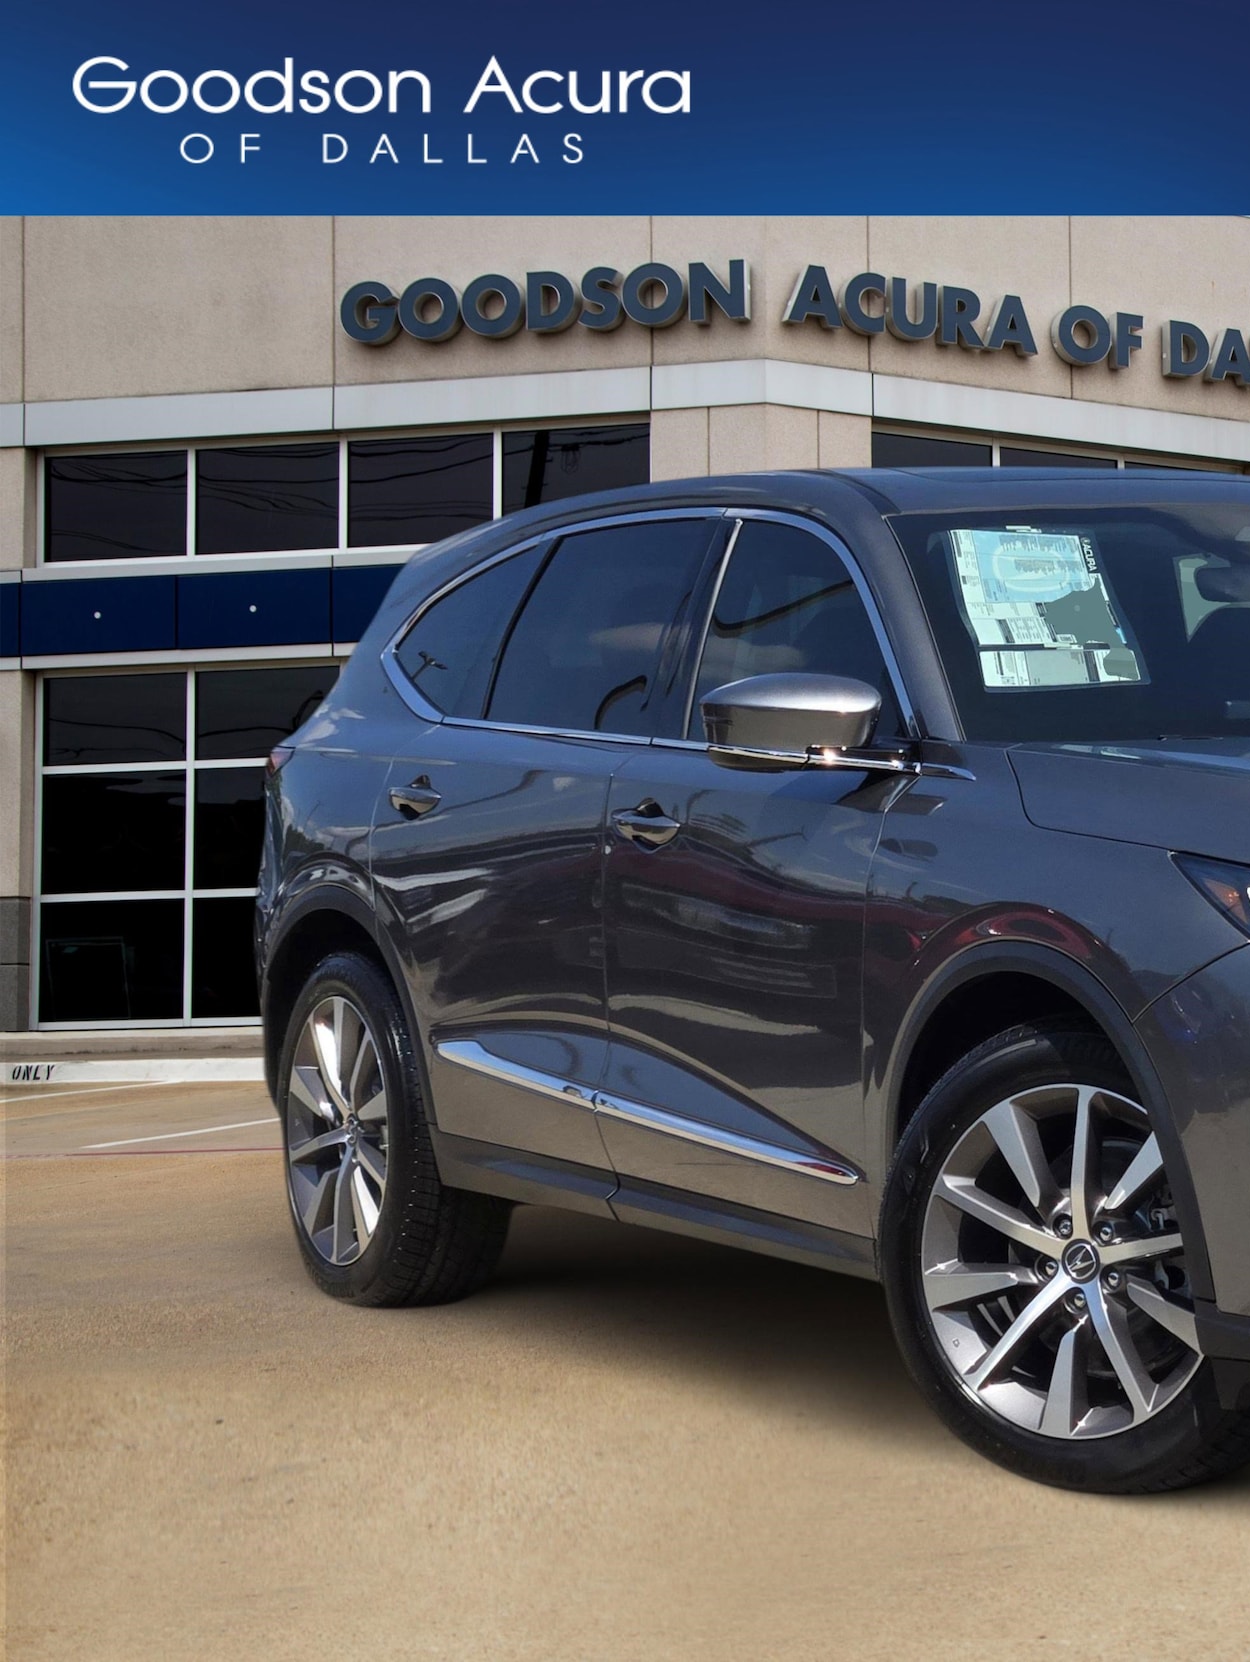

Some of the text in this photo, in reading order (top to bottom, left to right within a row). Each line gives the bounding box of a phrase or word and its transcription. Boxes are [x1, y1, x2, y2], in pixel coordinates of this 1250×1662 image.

[340, 259, 750, 346] GOODSON
[782, 264, 1038, 357] ACURA
[1051, 305, 1144, 369] OF
[1081, 543, 1097, 572] ACURA
[12, 1064, 55, 1081] ONLY
